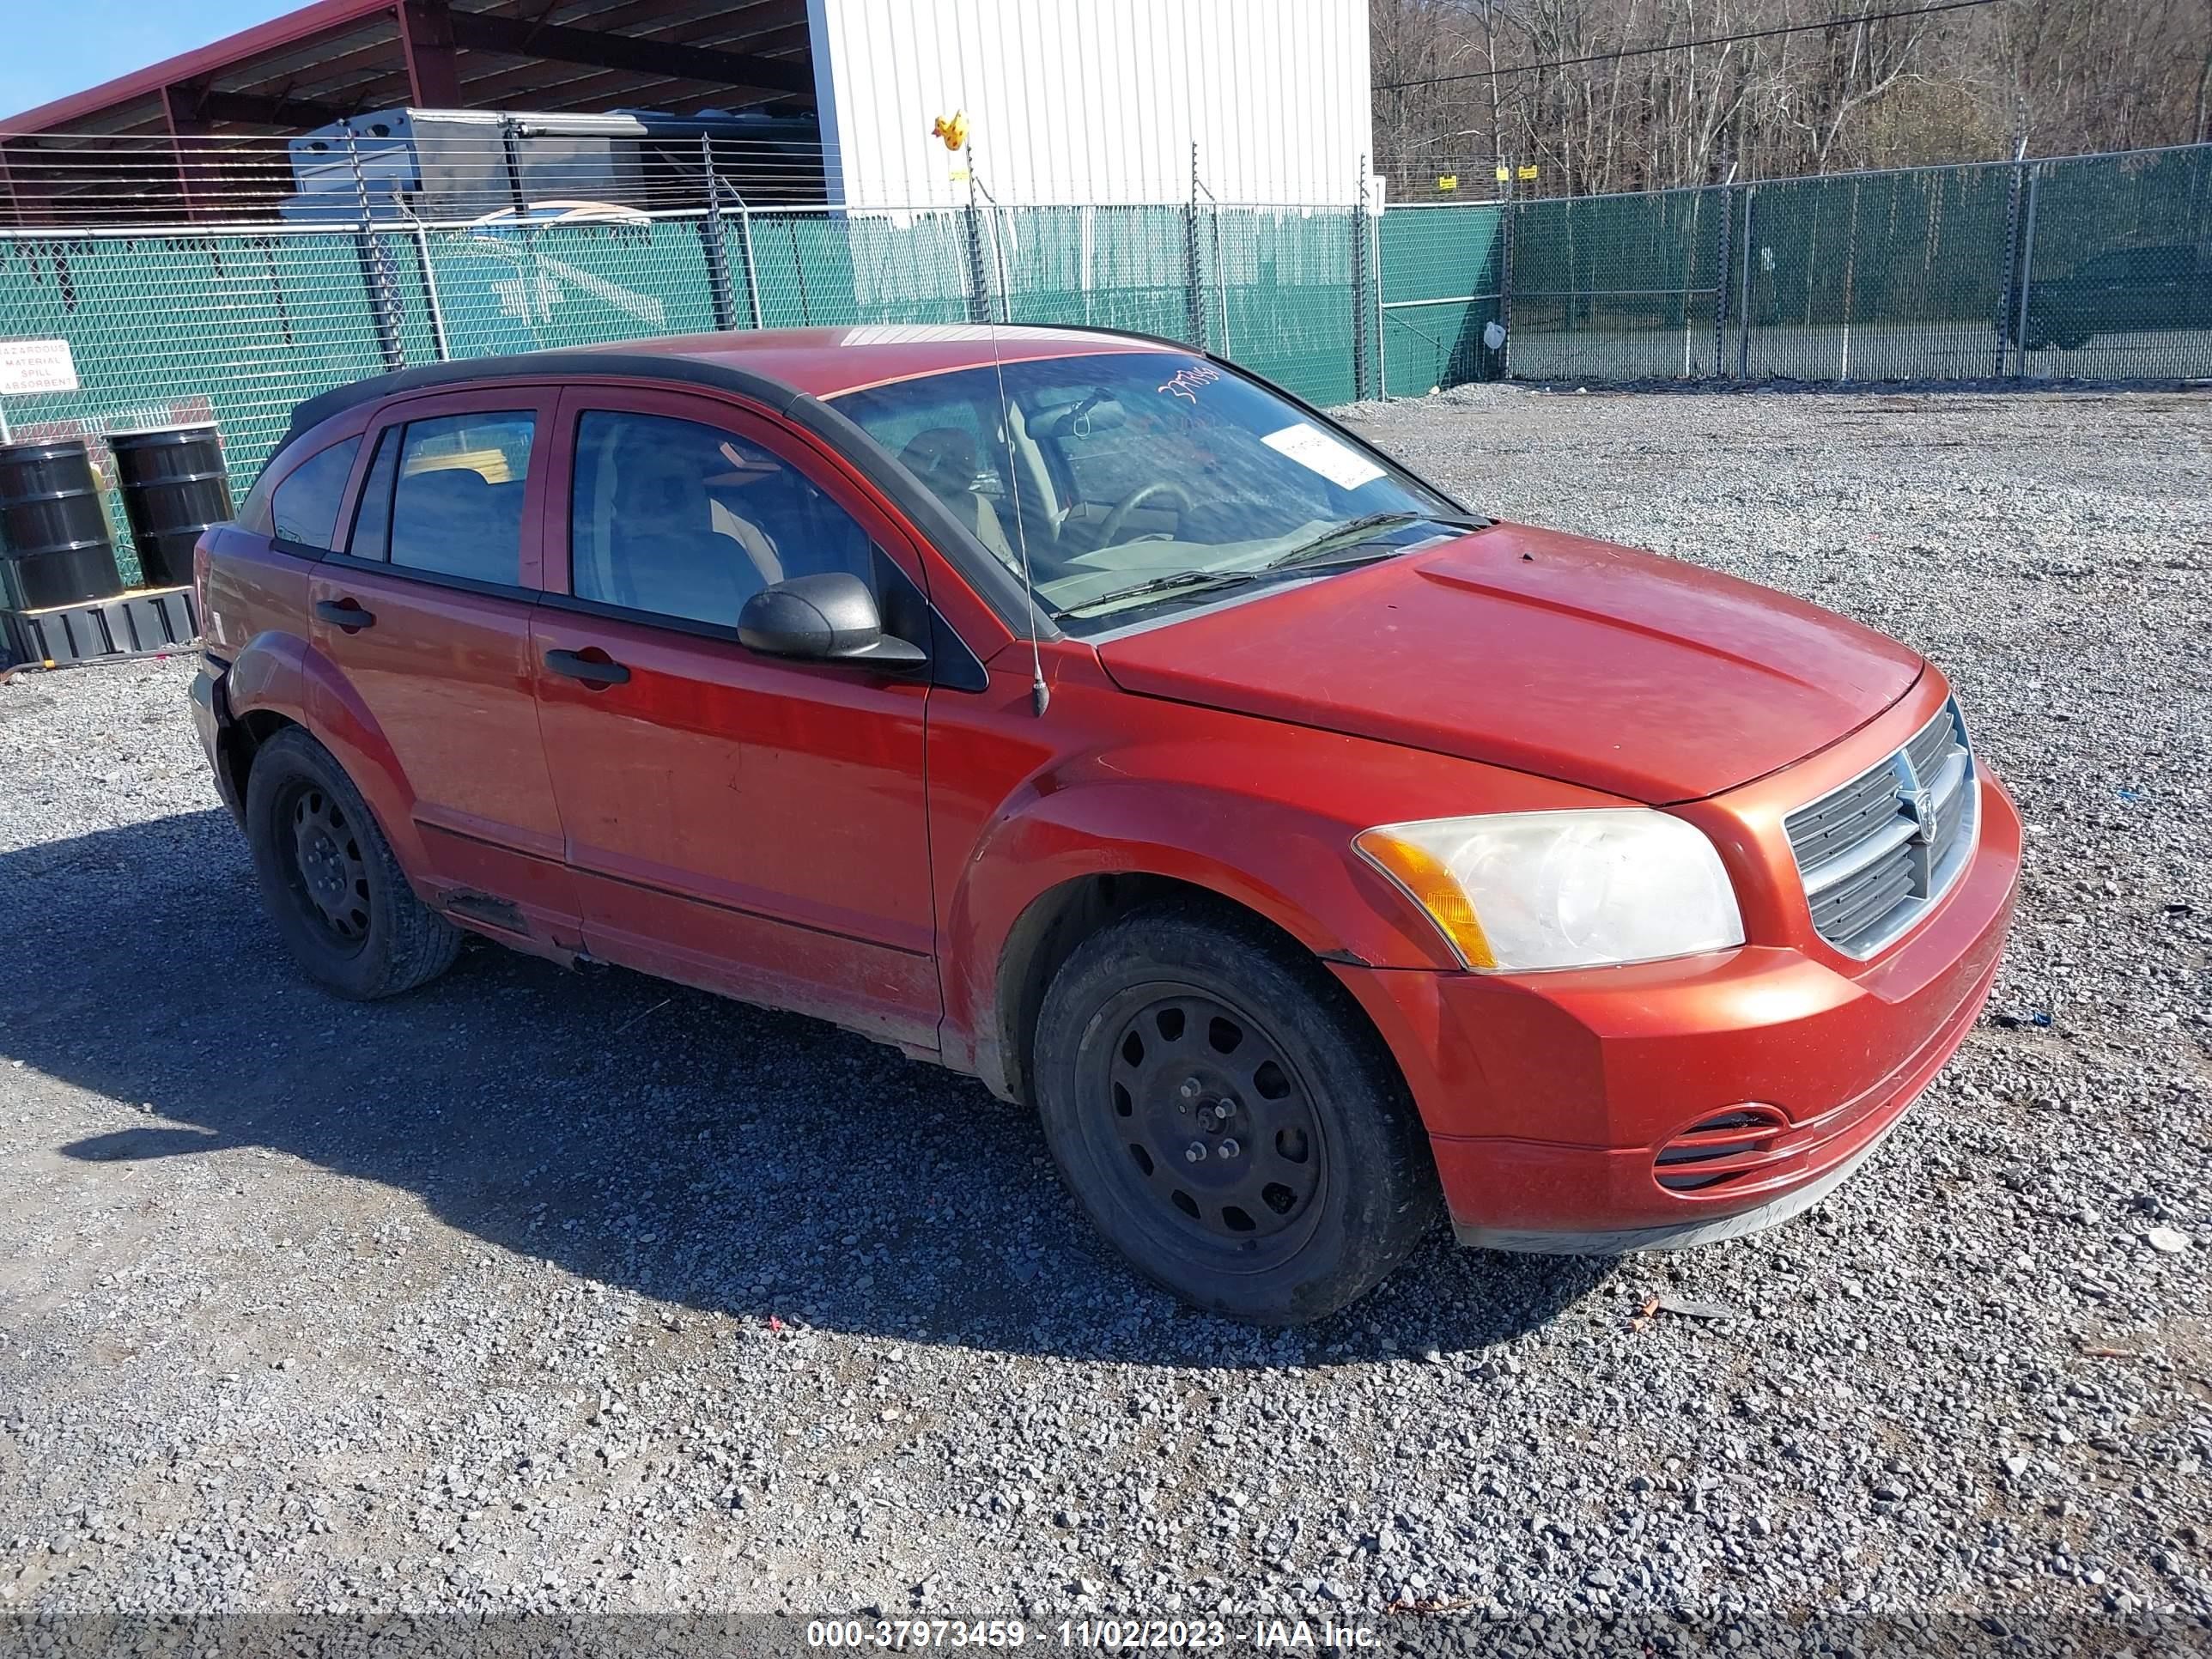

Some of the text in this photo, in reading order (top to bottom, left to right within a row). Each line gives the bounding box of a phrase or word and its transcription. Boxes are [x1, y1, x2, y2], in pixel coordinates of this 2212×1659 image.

[5, 356, 62, 367] MATERIAL
[21, 368, 52, 378] SPILL
[5, 378, 72, 391] ABSORBENT
